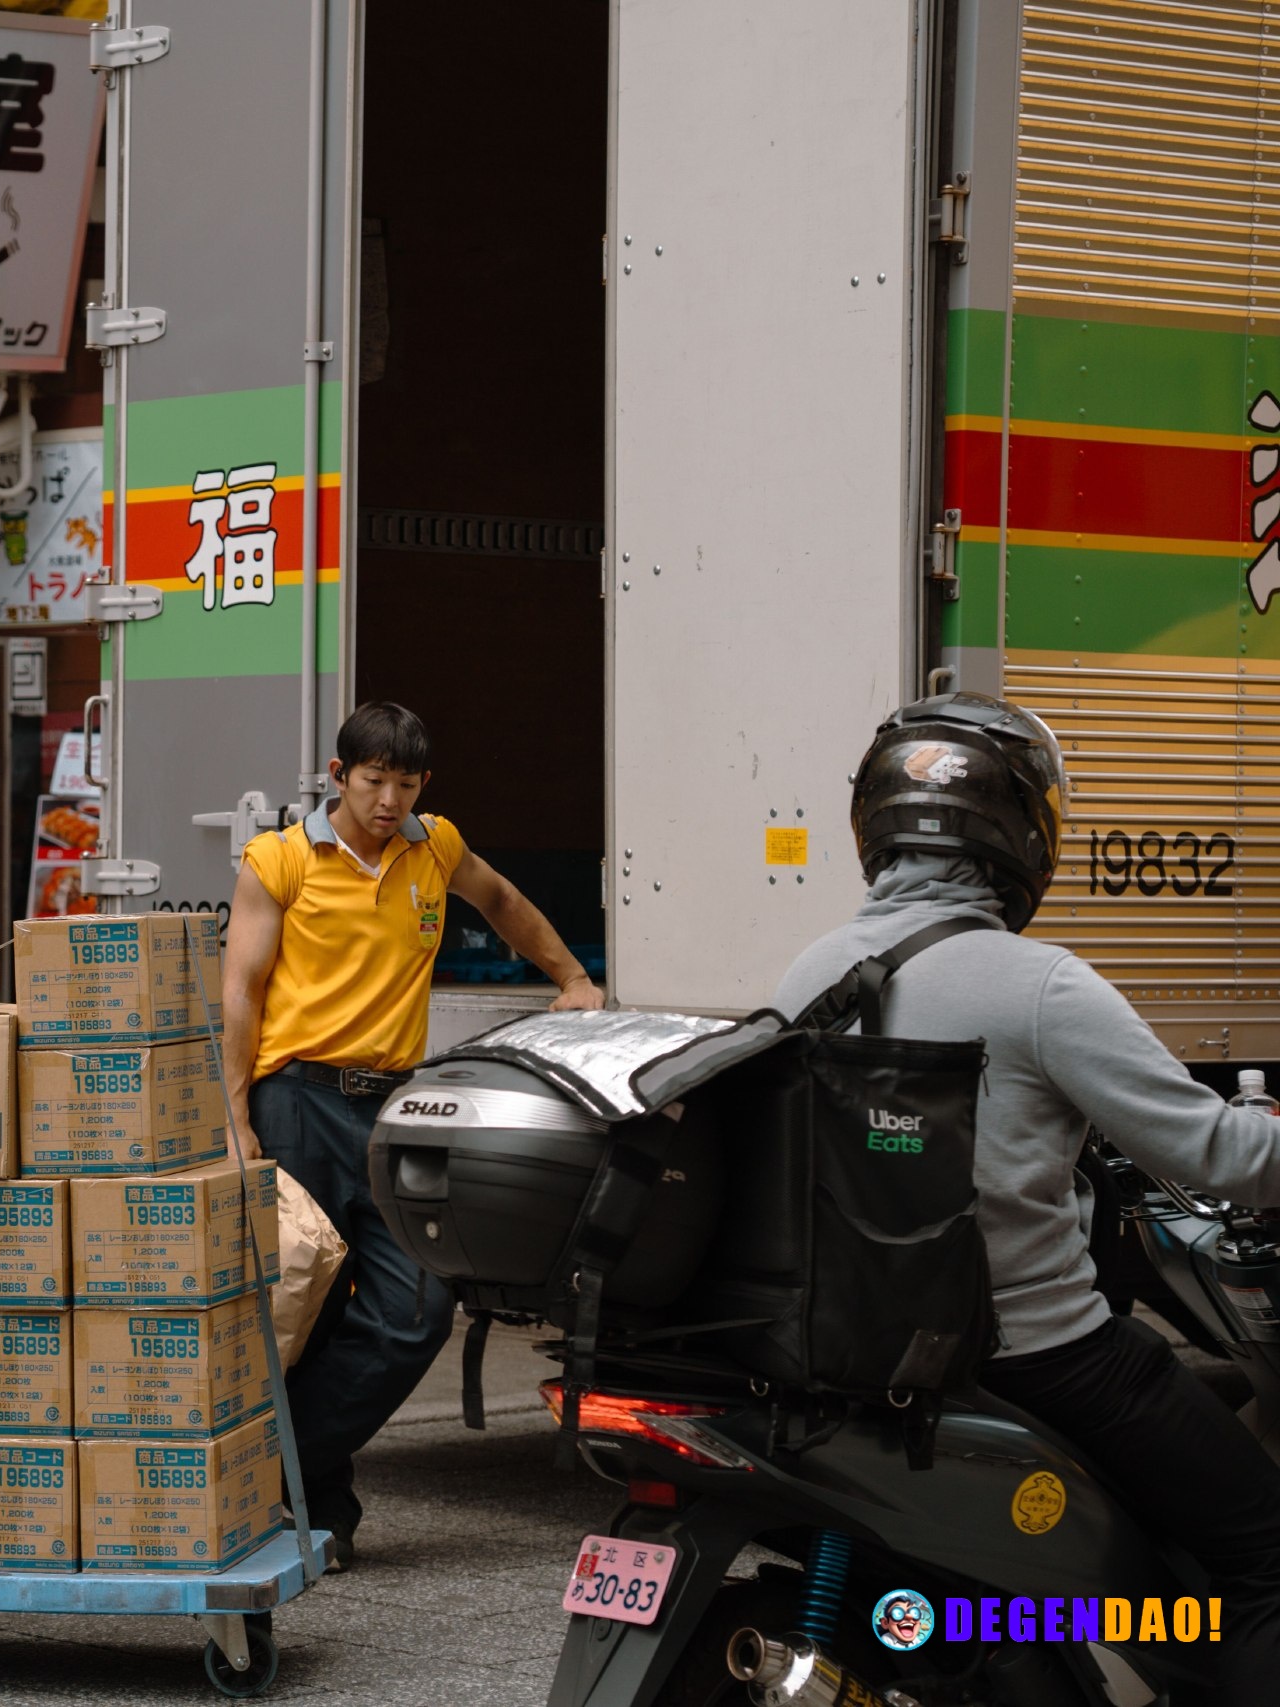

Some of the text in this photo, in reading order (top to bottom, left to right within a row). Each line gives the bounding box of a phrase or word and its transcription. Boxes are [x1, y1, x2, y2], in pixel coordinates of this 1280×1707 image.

[184, 461, 278, 612] 福
[1090, 829, 1235, 896] 19832
[71, 925, 137, 941] 商品コード
[71, 943, 138, 964] 195893
[73, 1020, 111, 1030] 195893
[74, 1055, 140, 1071] 商品コード
[74, 1073, 141, 1094] 195893
[399, 1101, 458, 1116] SHAD
[868, 1108, 924, 1131] Uber
[867, 1131, 924, 1153] Eats
[75, 1150, 113, 1160] 195893
[128, 1187, 193, 1201] 商品コード
[127, 1205, 195, 1225] 195893
[128, 1282, 166, 1291] 195893
[131, 1319, 198, 1335] 商品コード
[131, 1338, 199, 1358] 195893
[133, 1415, 171, 1423] 195893
[138, 1451, 205, 1464] 商品コード
[138, 1469, 206, 1488] 195893
[138, 1546, 177, 1556] 195893
